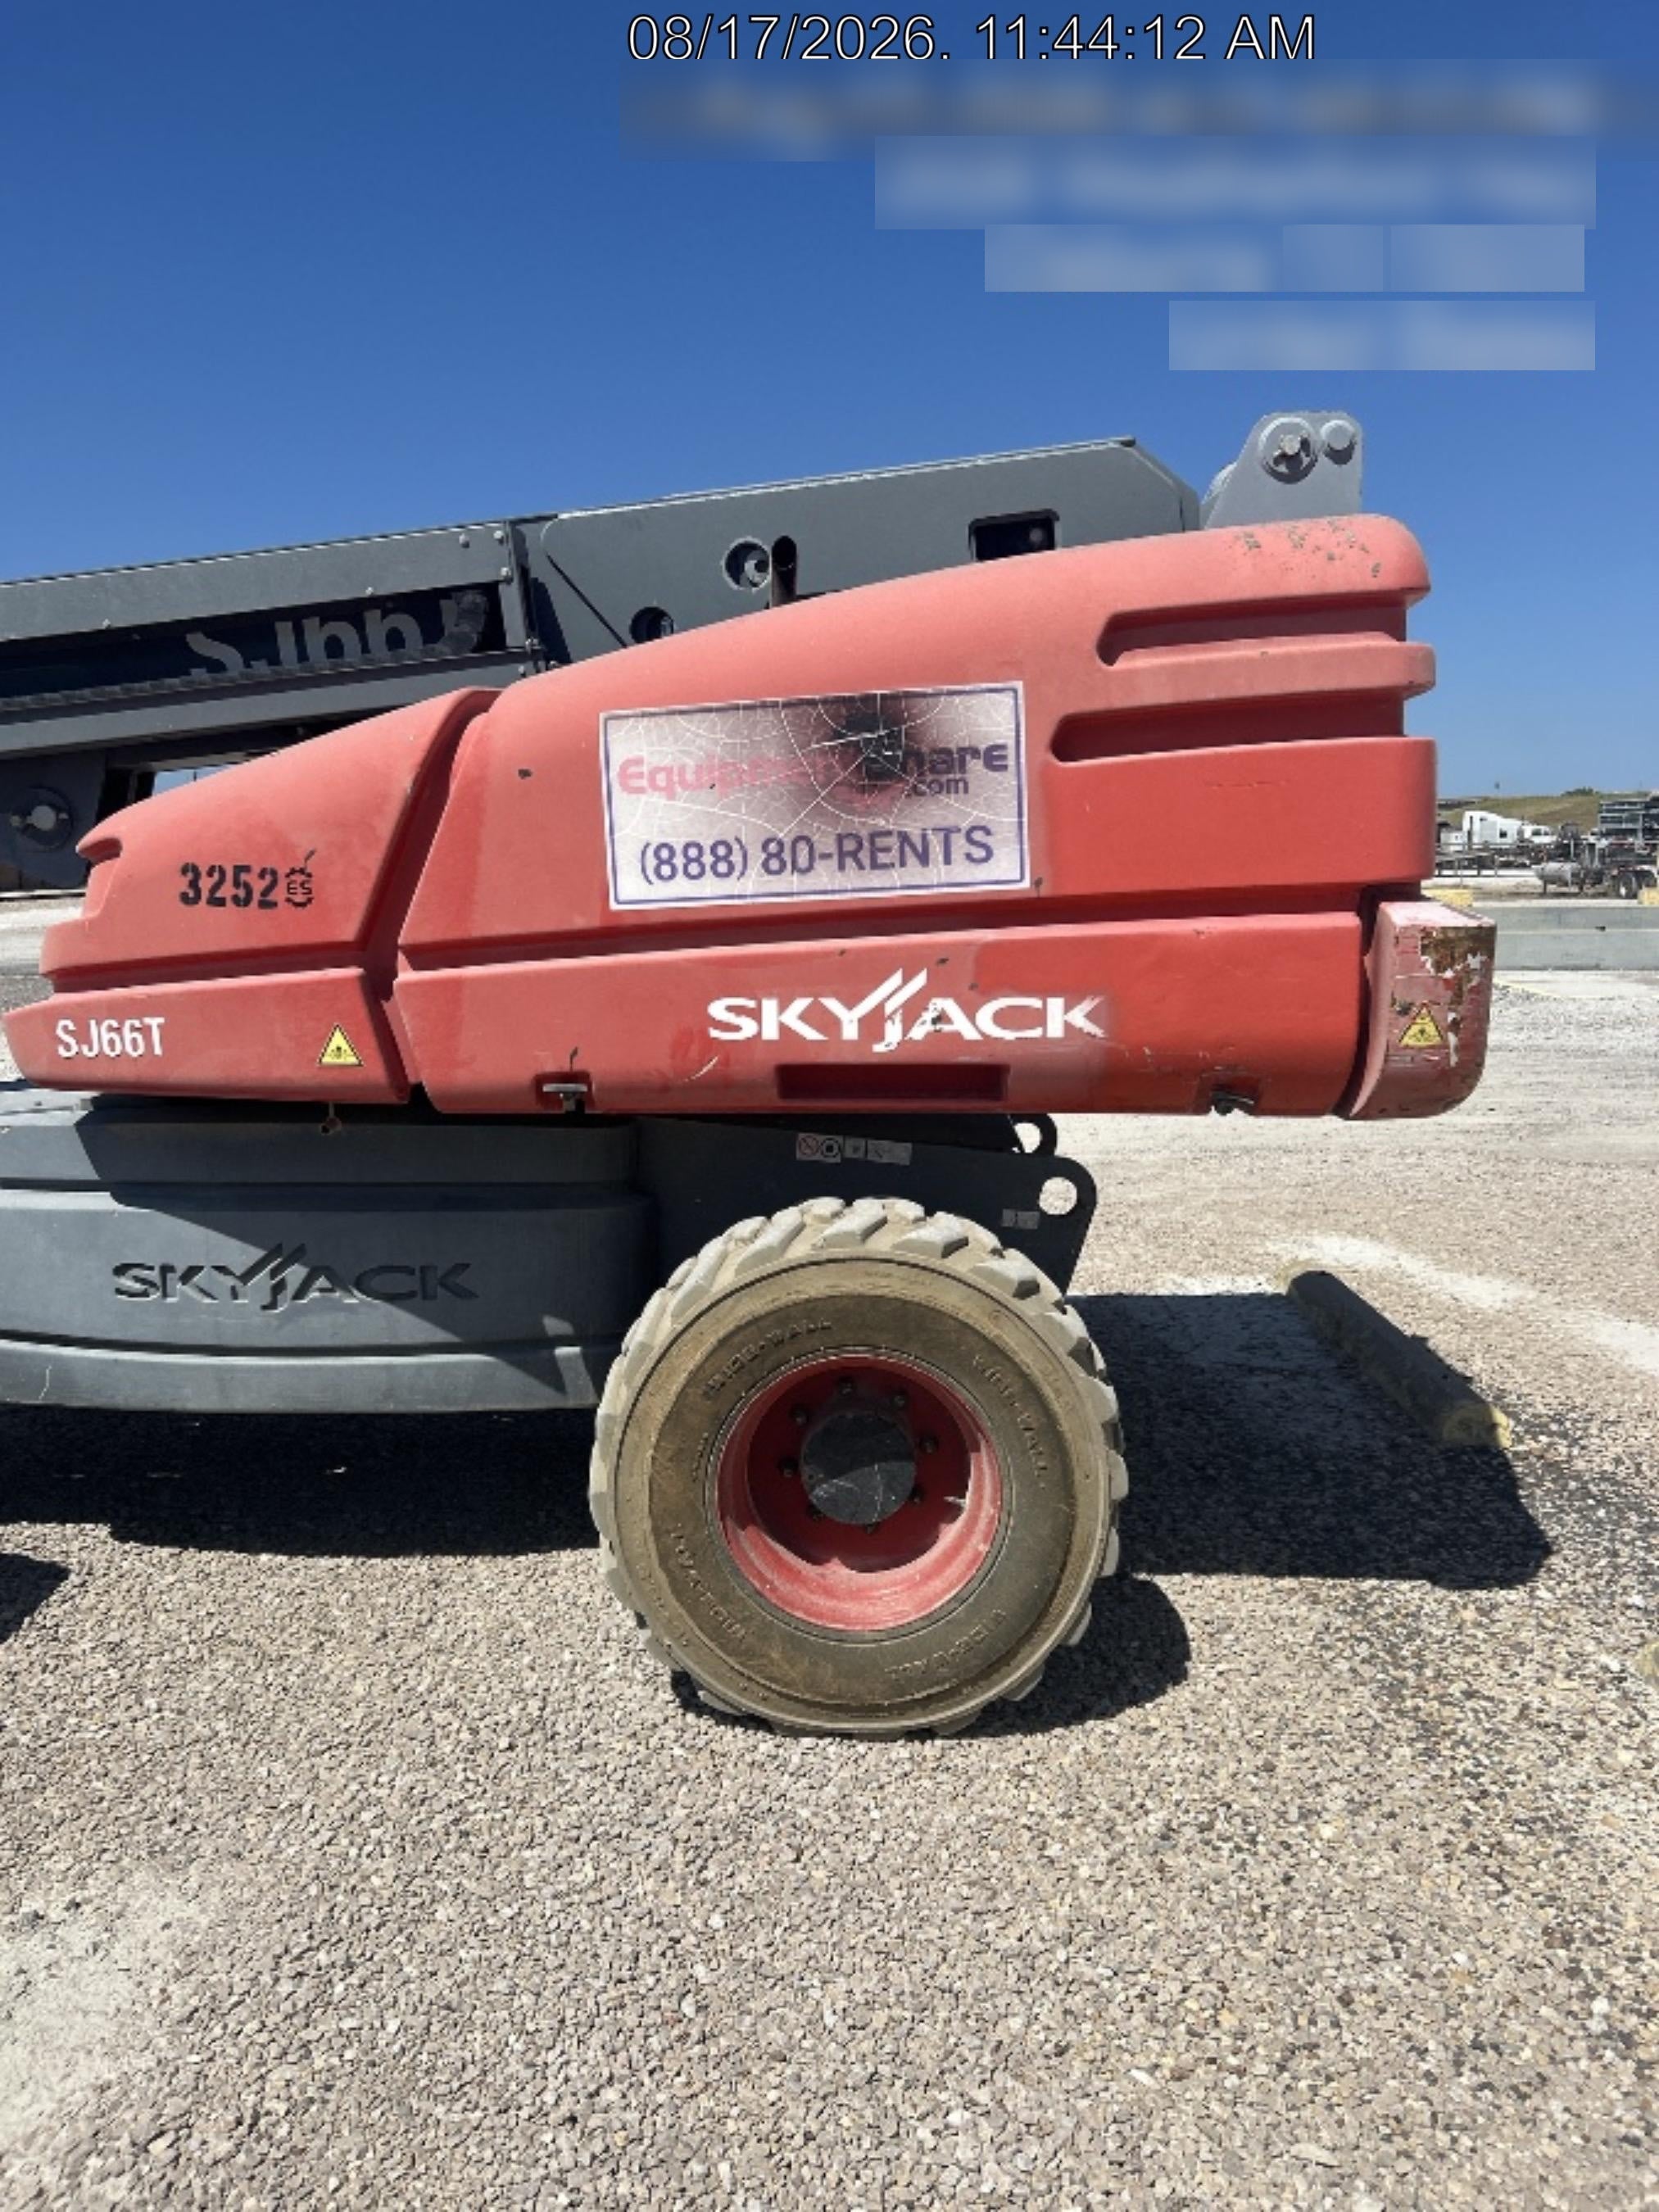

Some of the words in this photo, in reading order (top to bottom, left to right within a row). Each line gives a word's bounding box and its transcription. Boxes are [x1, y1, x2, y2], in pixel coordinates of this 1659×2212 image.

[905, 776, 969, 798] .com
[640, 836, 748, 886] (888)
[761, 825, 995, 877] 80-RENTS
[179, 862, 279, 909] 3252
[55, 1016, 165, 1059] SJ66T
[706, 968, 1106, 1053] SKYJACK
[112, 1243, 479, 1313] SKYJACK
